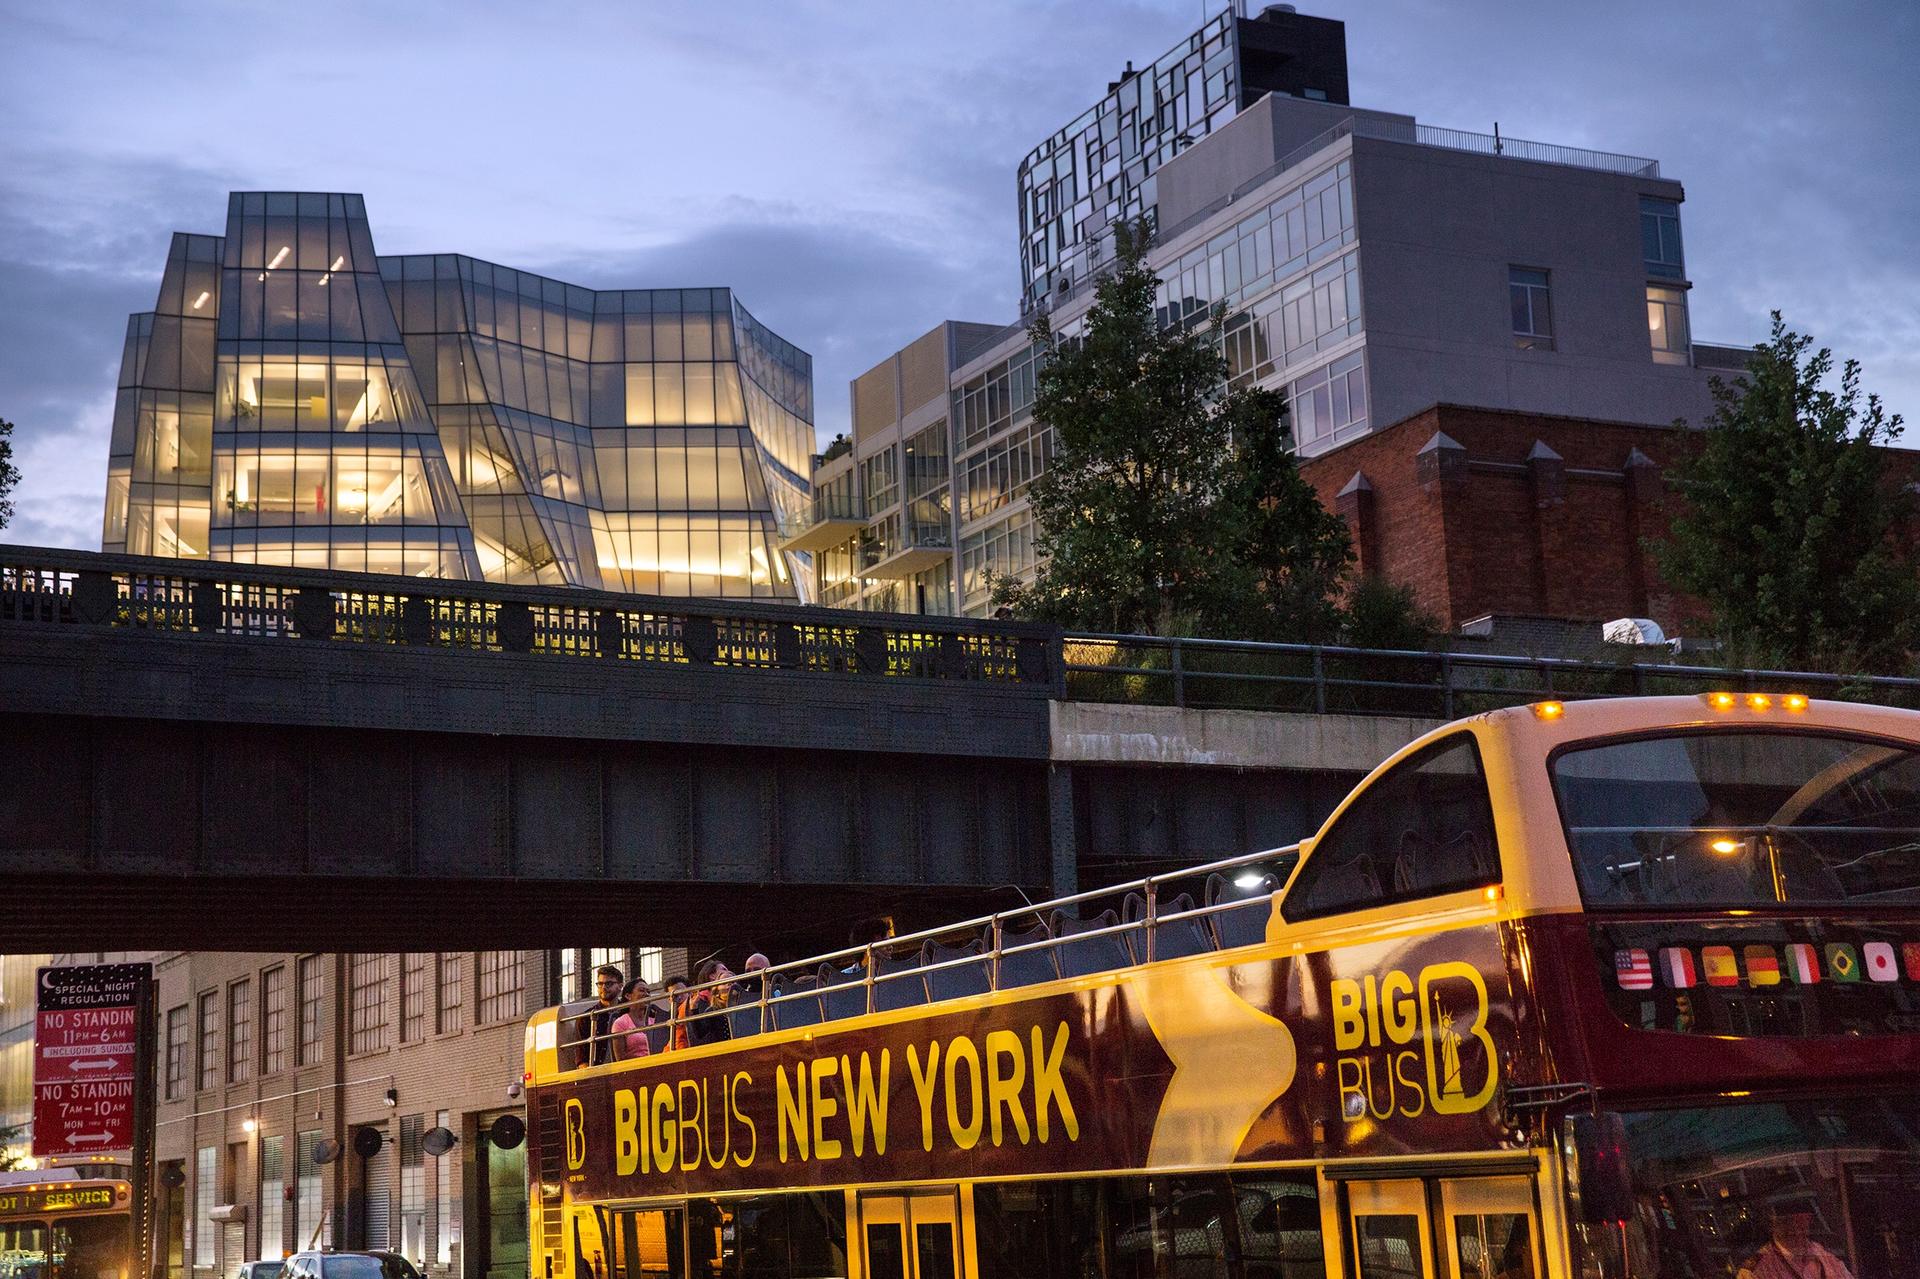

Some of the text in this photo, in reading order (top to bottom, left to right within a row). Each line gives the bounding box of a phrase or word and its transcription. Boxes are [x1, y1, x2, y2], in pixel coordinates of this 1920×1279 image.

[55, 982, 136, 995] SPECIAL NIGHT
[60, 993, 130, 1005] REGULATION
[1330, 970, 1417, 1051] BIG
[44, 1010, 134, 1029] NO STANDIN
[49, 1047, 97, 1056] INCLUDING
[42, 1081, 132, 1100] NO STANDIN
[776, 1047, 891, 1164] NEW
[906, 1020, 1080, 1152] YORK
[1337, 1050, 1425, 1123] BUS
[64, 1120, 83, 1129] MON
[105, 1118, 120, 1127] FRI
[0, 1197, 17, 1209] OT
